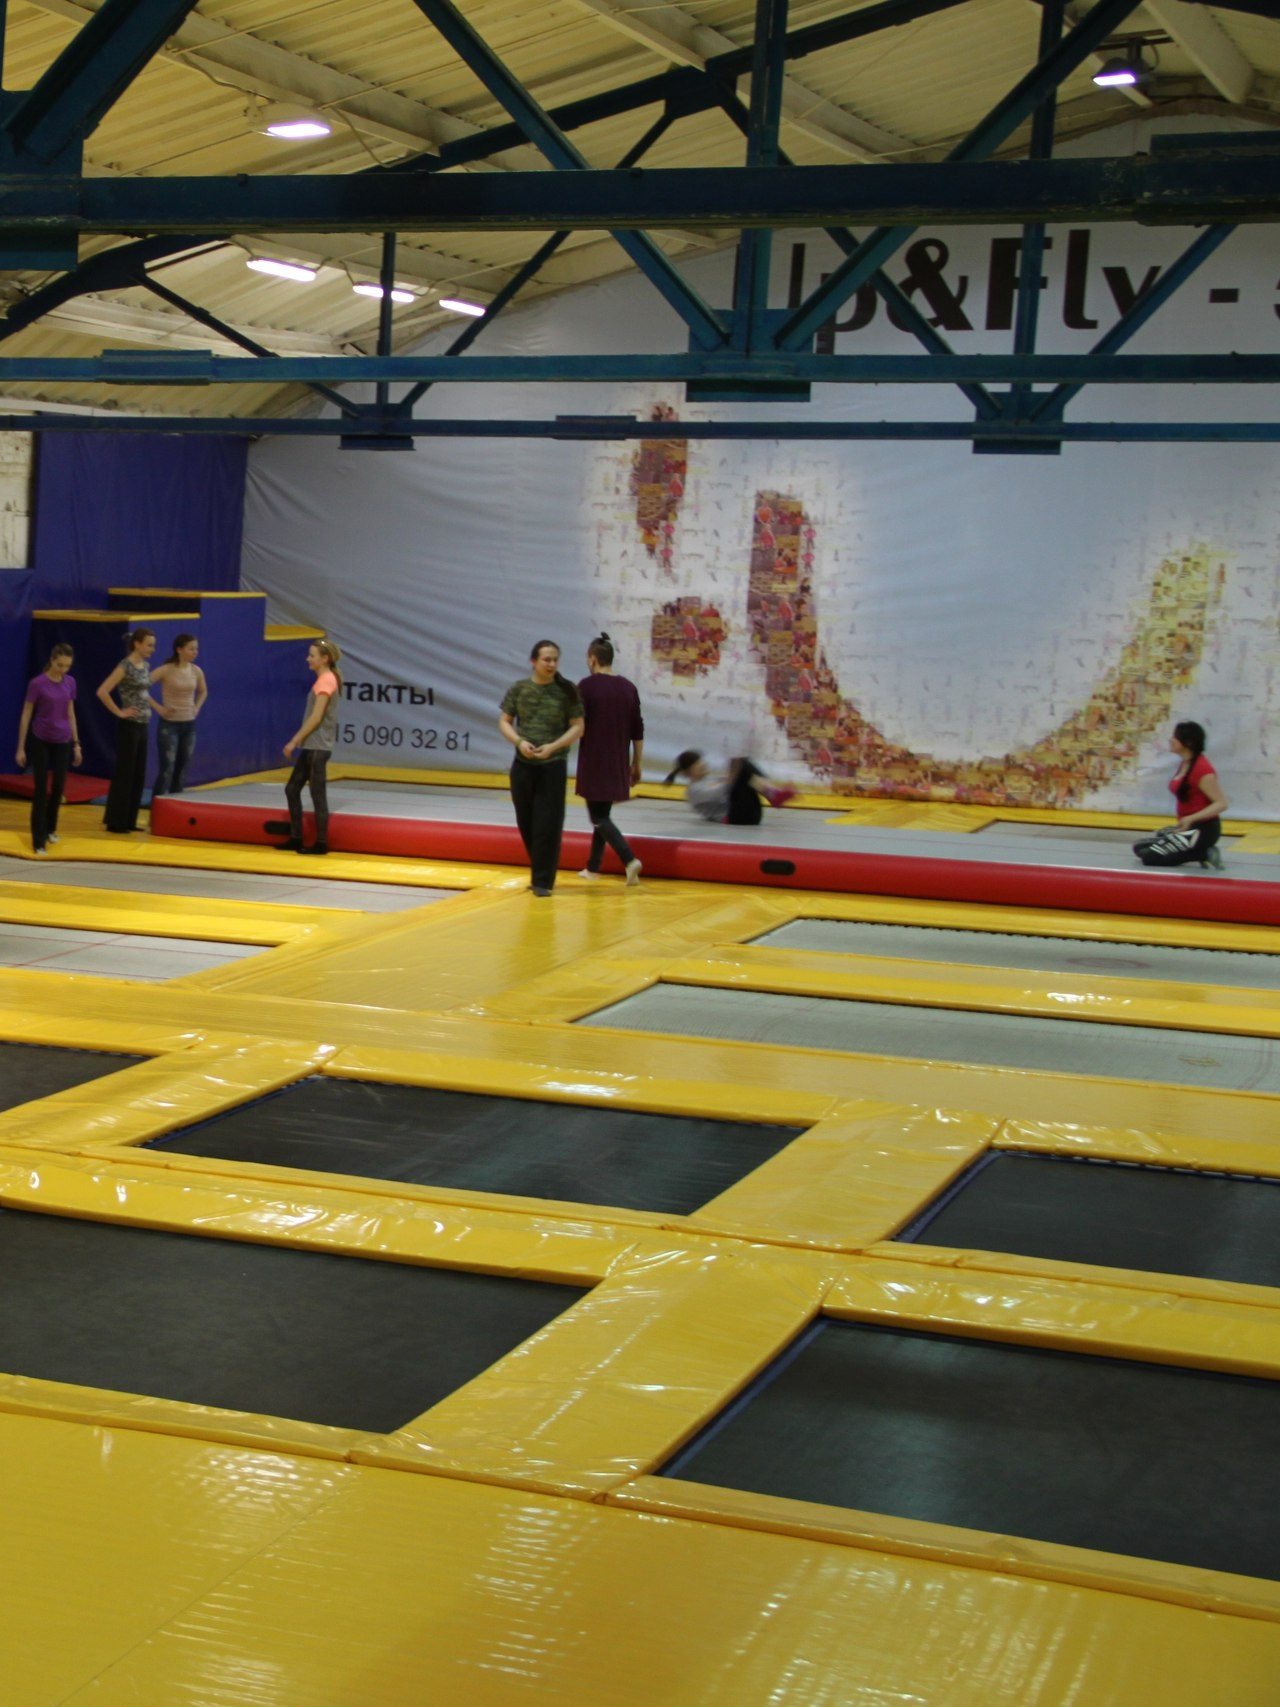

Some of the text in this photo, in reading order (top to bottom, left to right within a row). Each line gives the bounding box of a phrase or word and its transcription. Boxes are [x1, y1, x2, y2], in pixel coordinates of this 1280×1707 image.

[342, 682, 435, 706] такты
[335, 723, 471, 751] 15 090 32 81
